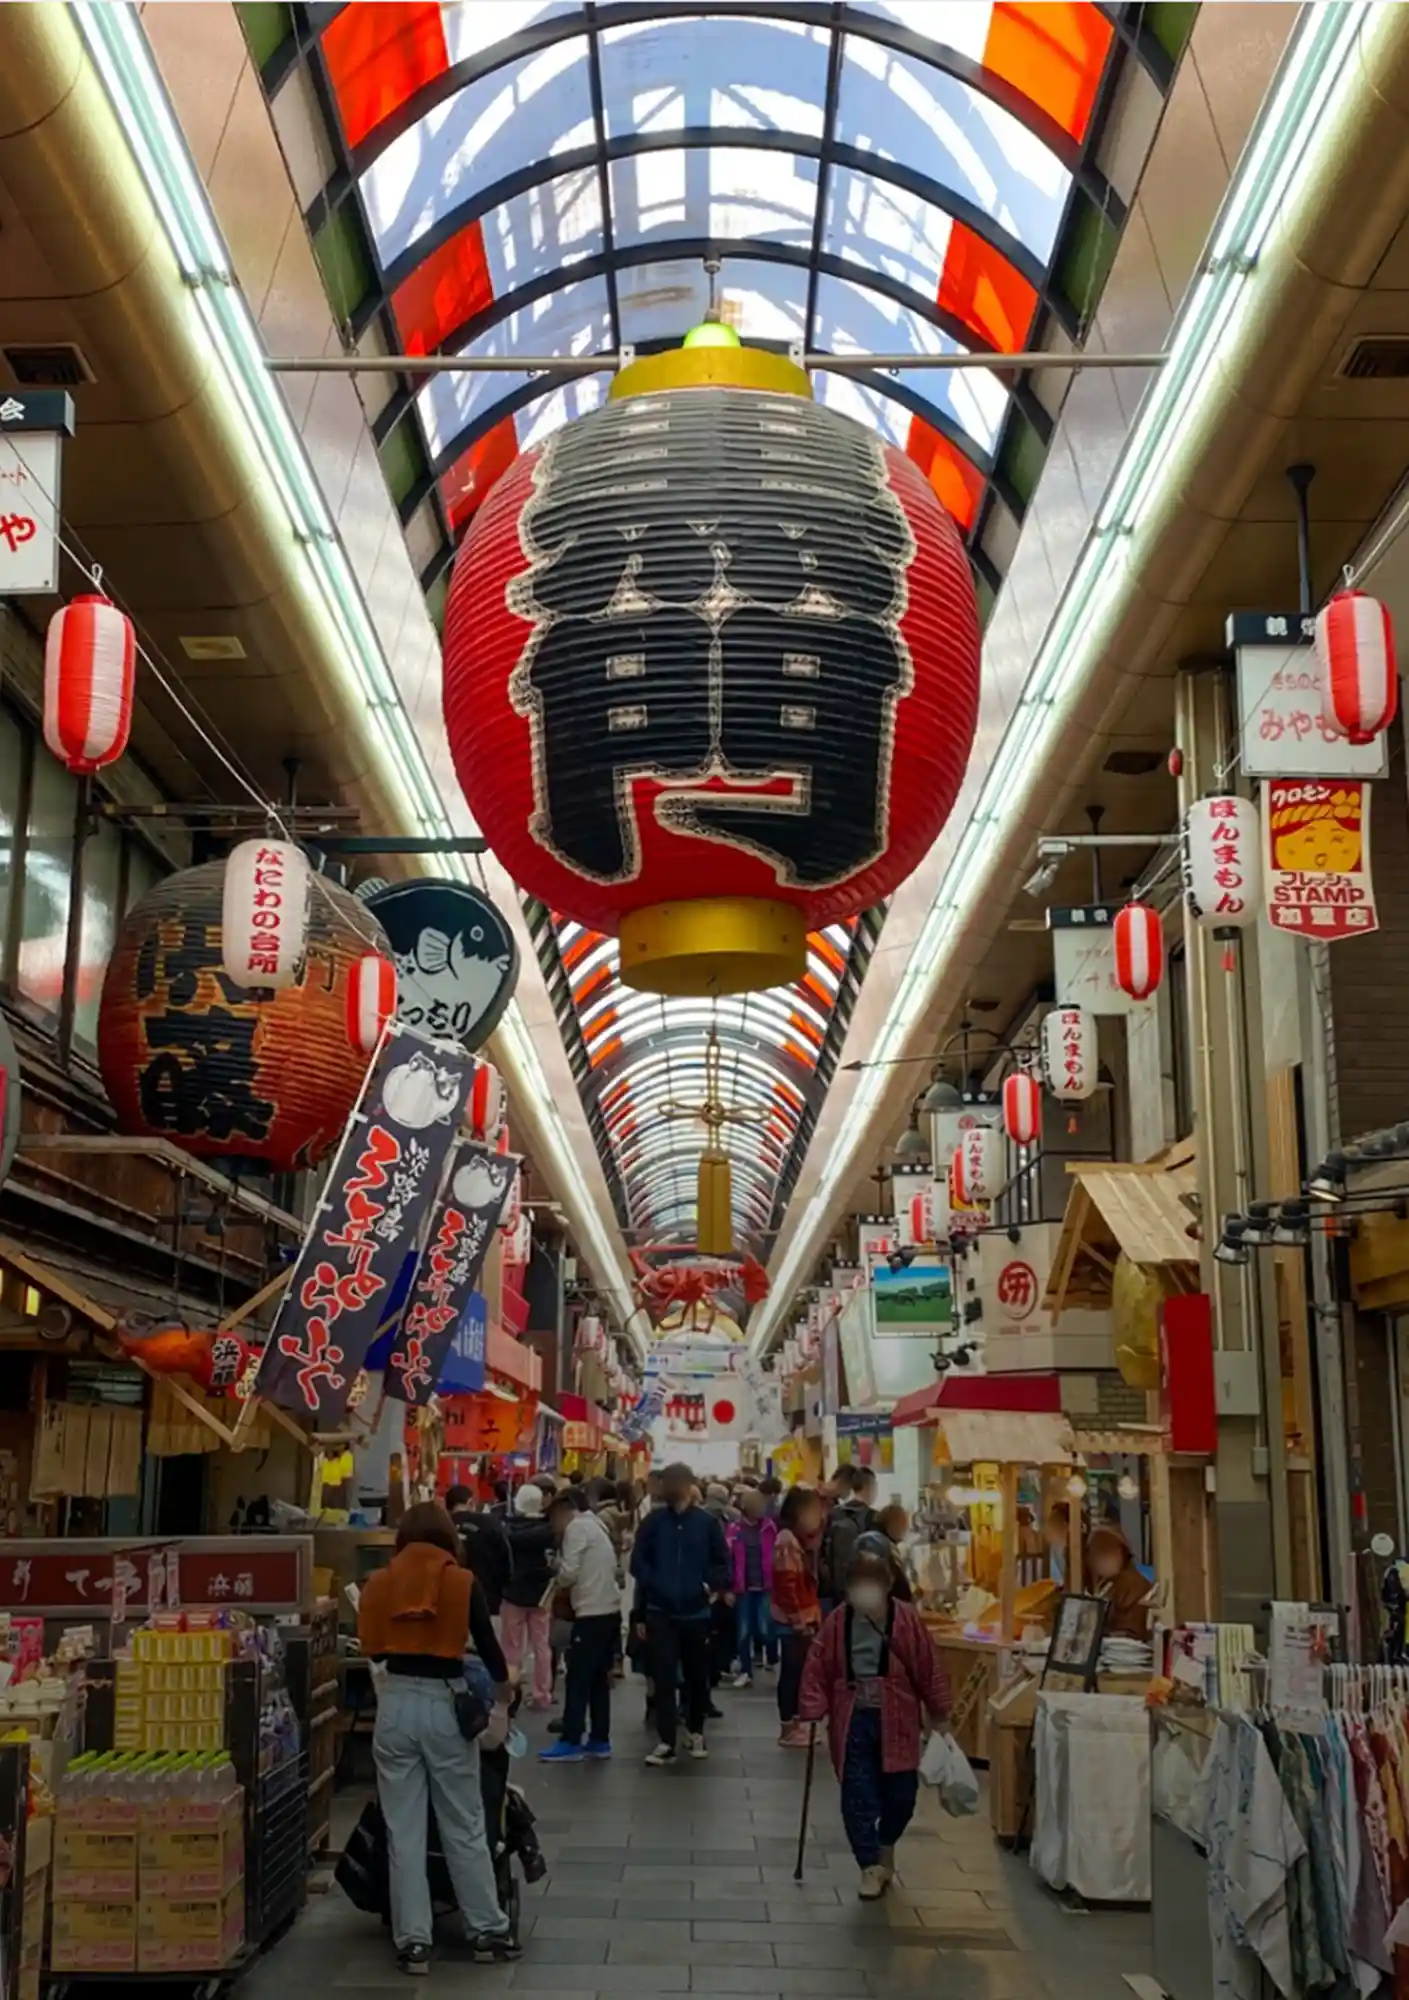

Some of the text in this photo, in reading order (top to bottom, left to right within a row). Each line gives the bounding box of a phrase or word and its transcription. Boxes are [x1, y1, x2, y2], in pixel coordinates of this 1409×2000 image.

[1272, 784, 1331, 807] クロモン
[1209, 800, 1244, 913] ほんまもん
[1274, 885, 1365, 903] STAMP
[248, 848, 282, 975] なにわの台所
[1060, 1012, 1083, 1091] ほんまもん
